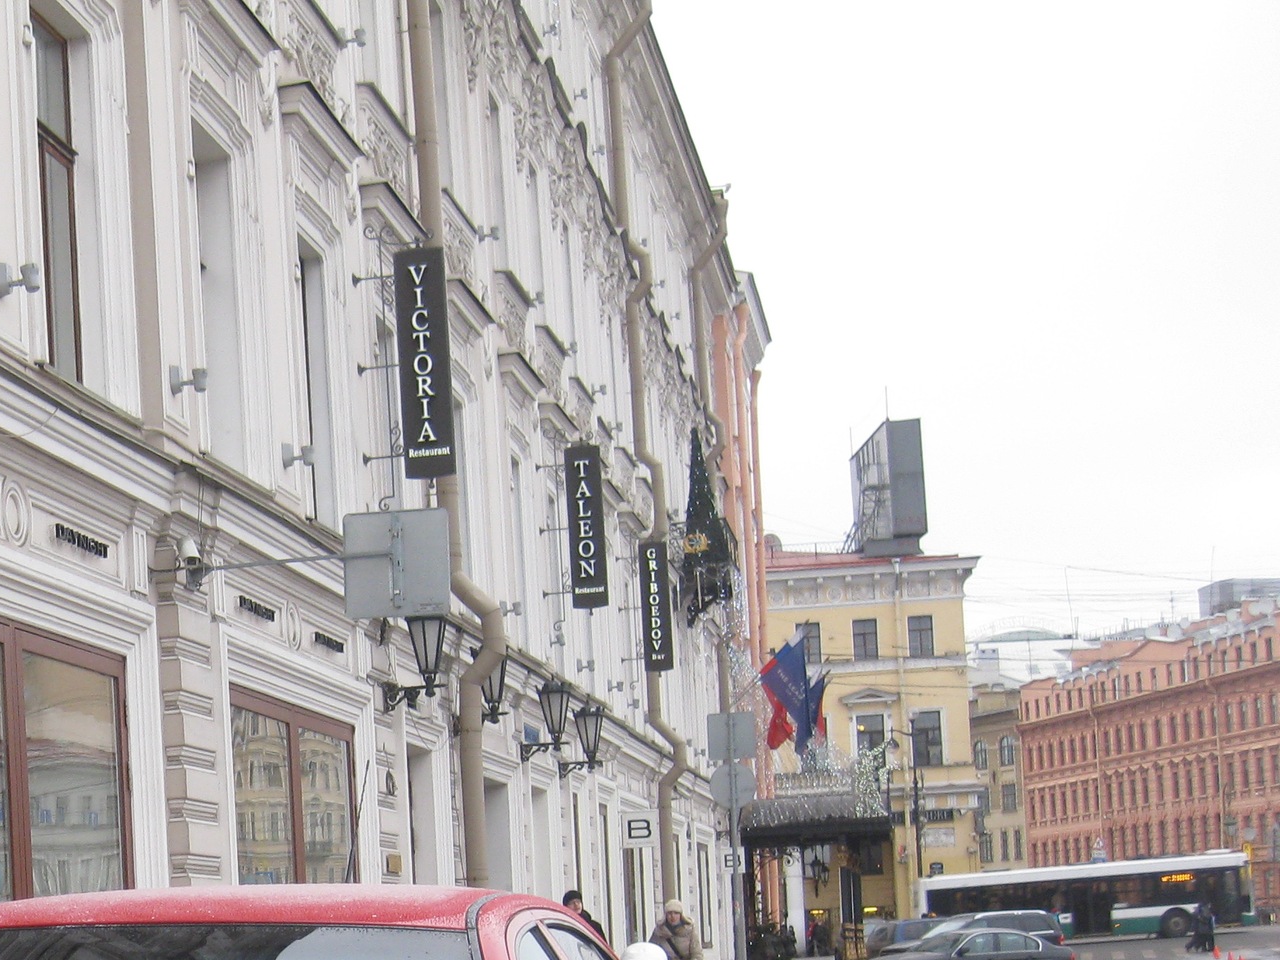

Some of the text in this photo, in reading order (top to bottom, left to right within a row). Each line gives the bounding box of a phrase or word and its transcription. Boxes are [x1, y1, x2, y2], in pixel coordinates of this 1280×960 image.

[407, 264, 437, 443] VICTORIA
[408, 445, 451, 459] Restaurant
[574, 459, 597, 578] TALEON
[646, 548, 662, 652] GRIBOEDOV
[627, 819, 652, 839] B
